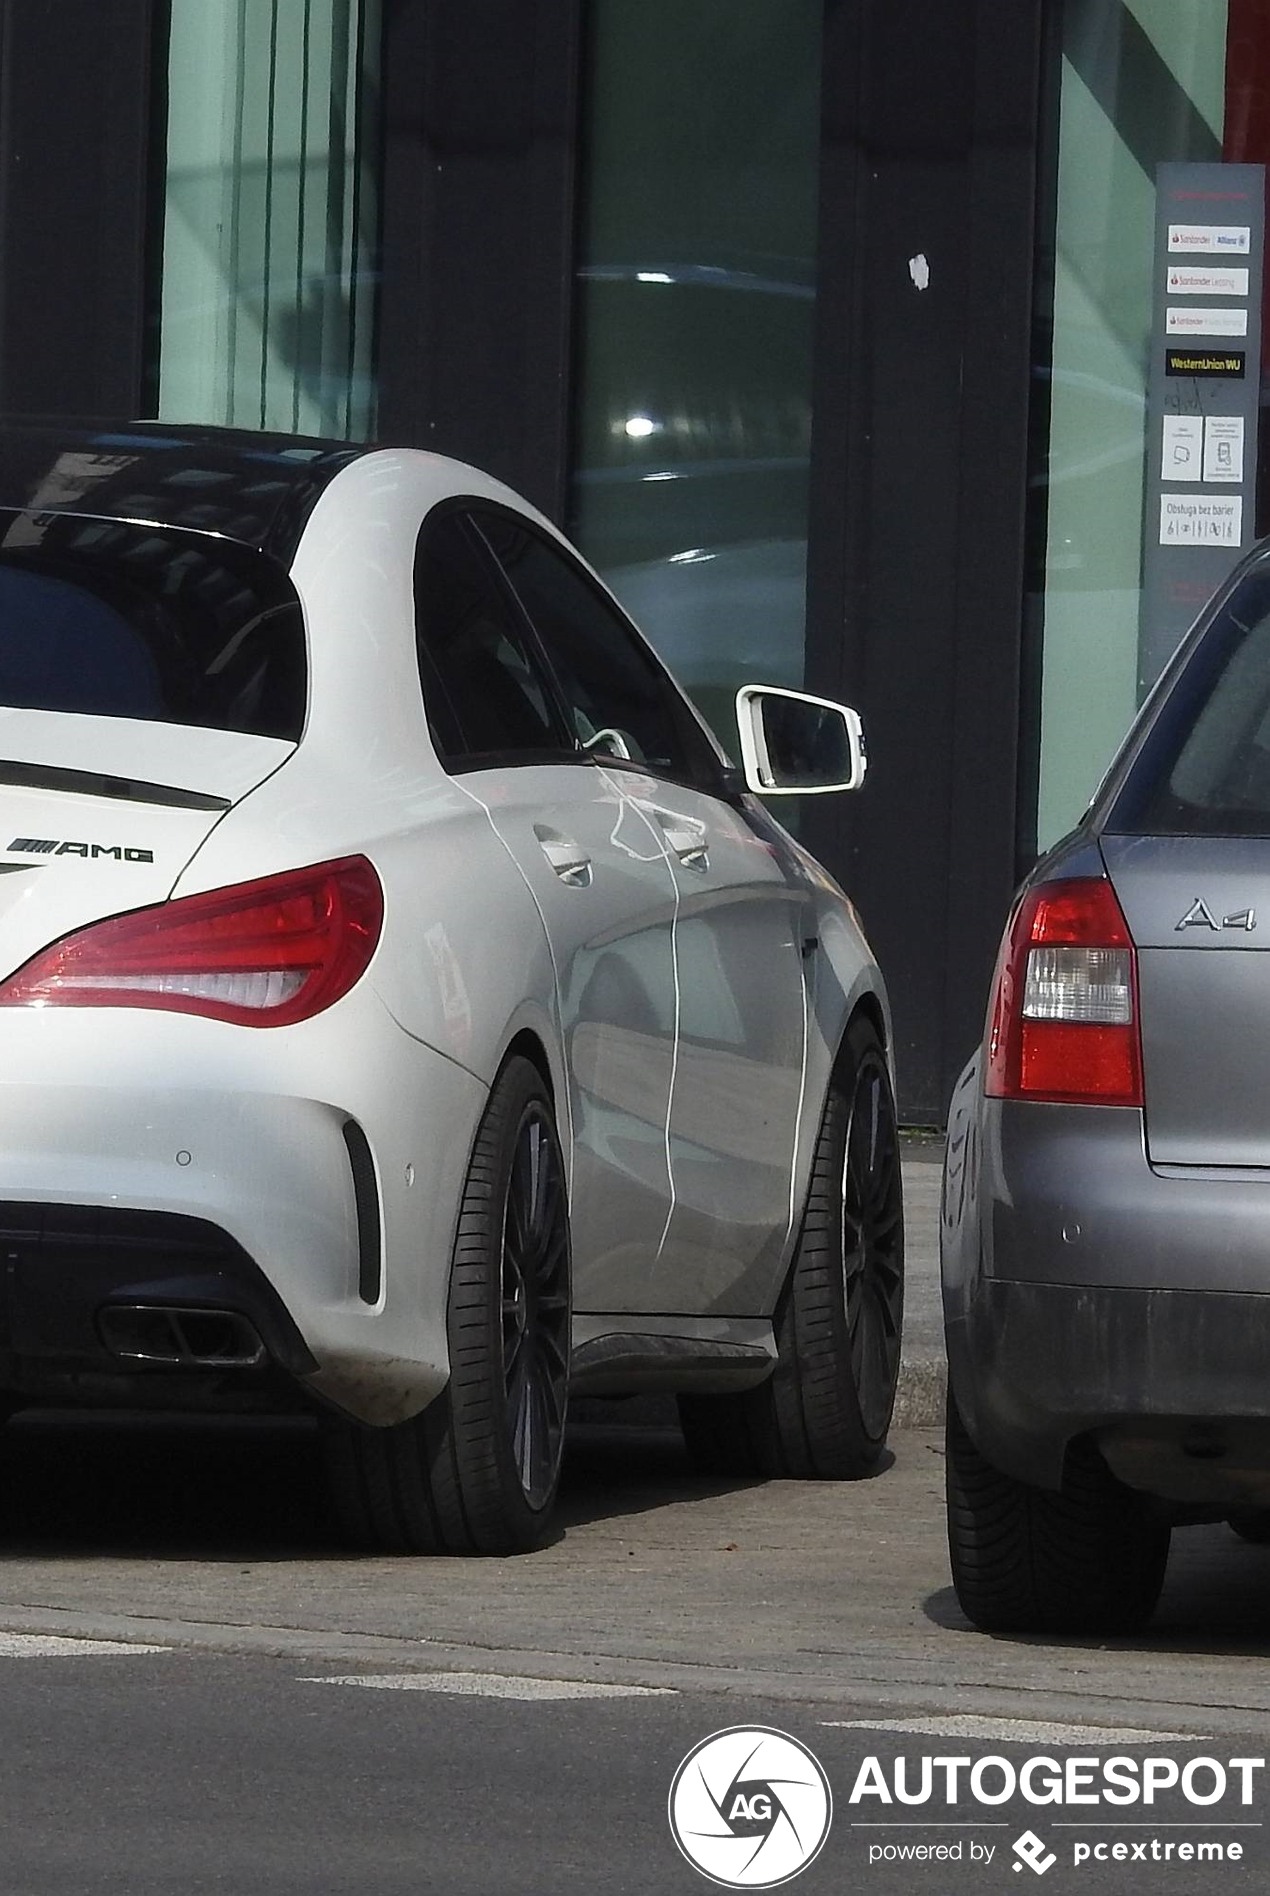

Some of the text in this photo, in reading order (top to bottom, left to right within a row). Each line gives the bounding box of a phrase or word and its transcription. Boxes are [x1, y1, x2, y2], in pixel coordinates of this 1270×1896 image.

[1179, 276, 1211, 286] Santander
[1167, 503, 1234, 517] Obsługa bez barier
[1175, 898, 1257, 932] A4
